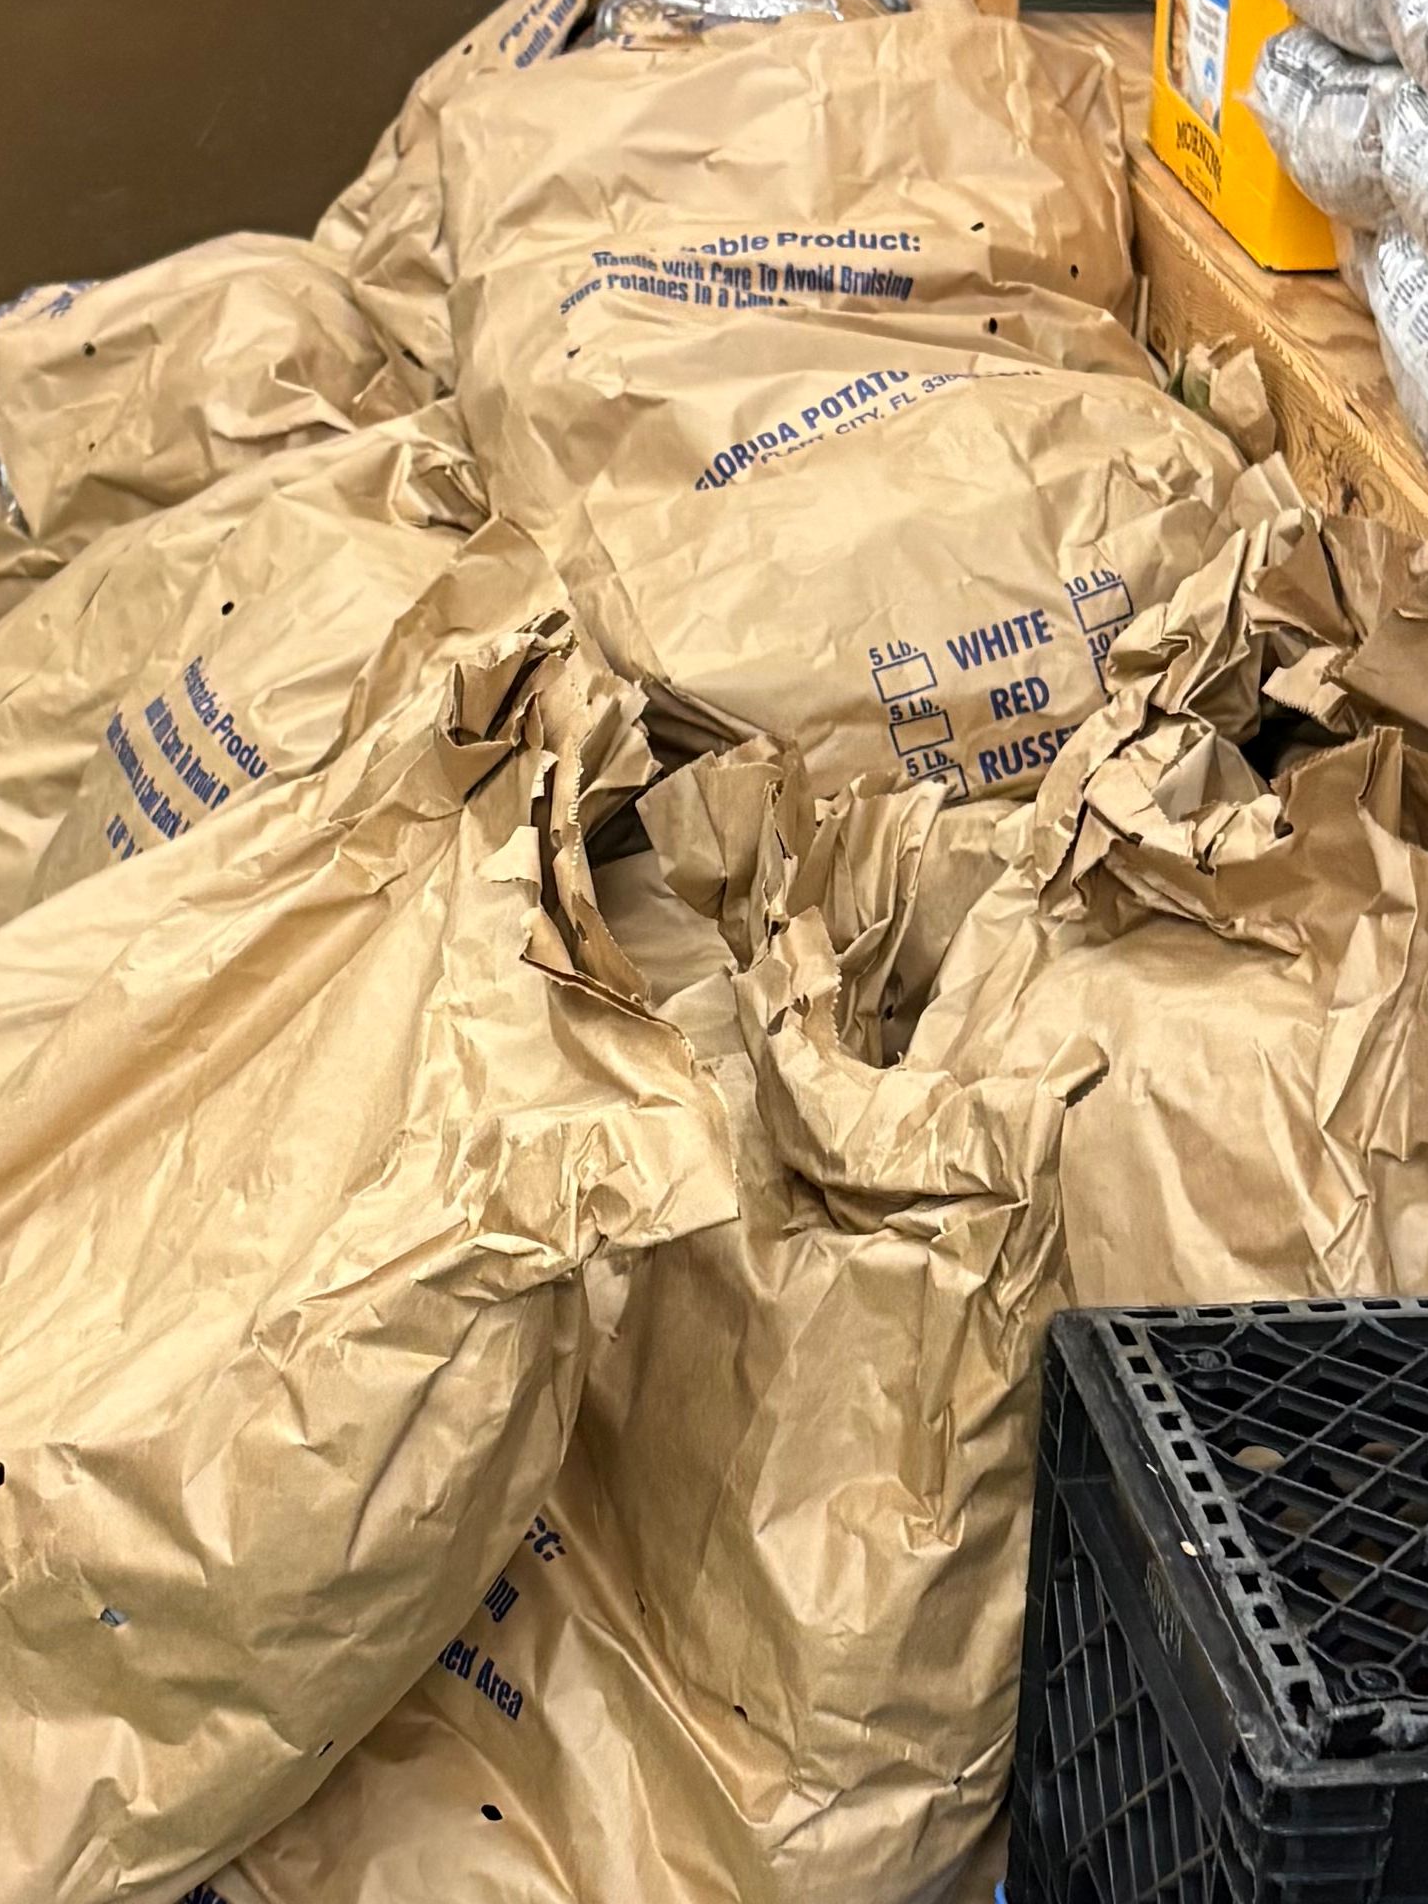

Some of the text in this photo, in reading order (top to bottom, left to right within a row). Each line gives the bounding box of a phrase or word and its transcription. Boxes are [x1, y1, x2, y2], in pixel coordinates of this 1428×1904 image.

[776, 229, 921, 252] Product:
[606, 273, 689, 302] Potatoes
[717, 287, 729, 308] a
[662, 260, 704, 281] With
[710, 261, 752, 291] Care
[759, 262, 777, 292] To
[784, 262, 835, 294] Avoid
[839, 265, 914, 302] Bruising
[889, 391, 917, 412] FL
[1064, 567, 1122, 597] 10 Lb.
[869, 639, 918, 666] 5 Lb.
[946, 608, 1054, 672] WHITE
[889, 697, 940, 722] 5 Lb.
[990, 676, 1050, 721] RED
[211, 712, 268, 779] Produ
[905, 751, 955, 778] 5 Lb.
[475, 1656, 524, 1721] Area
